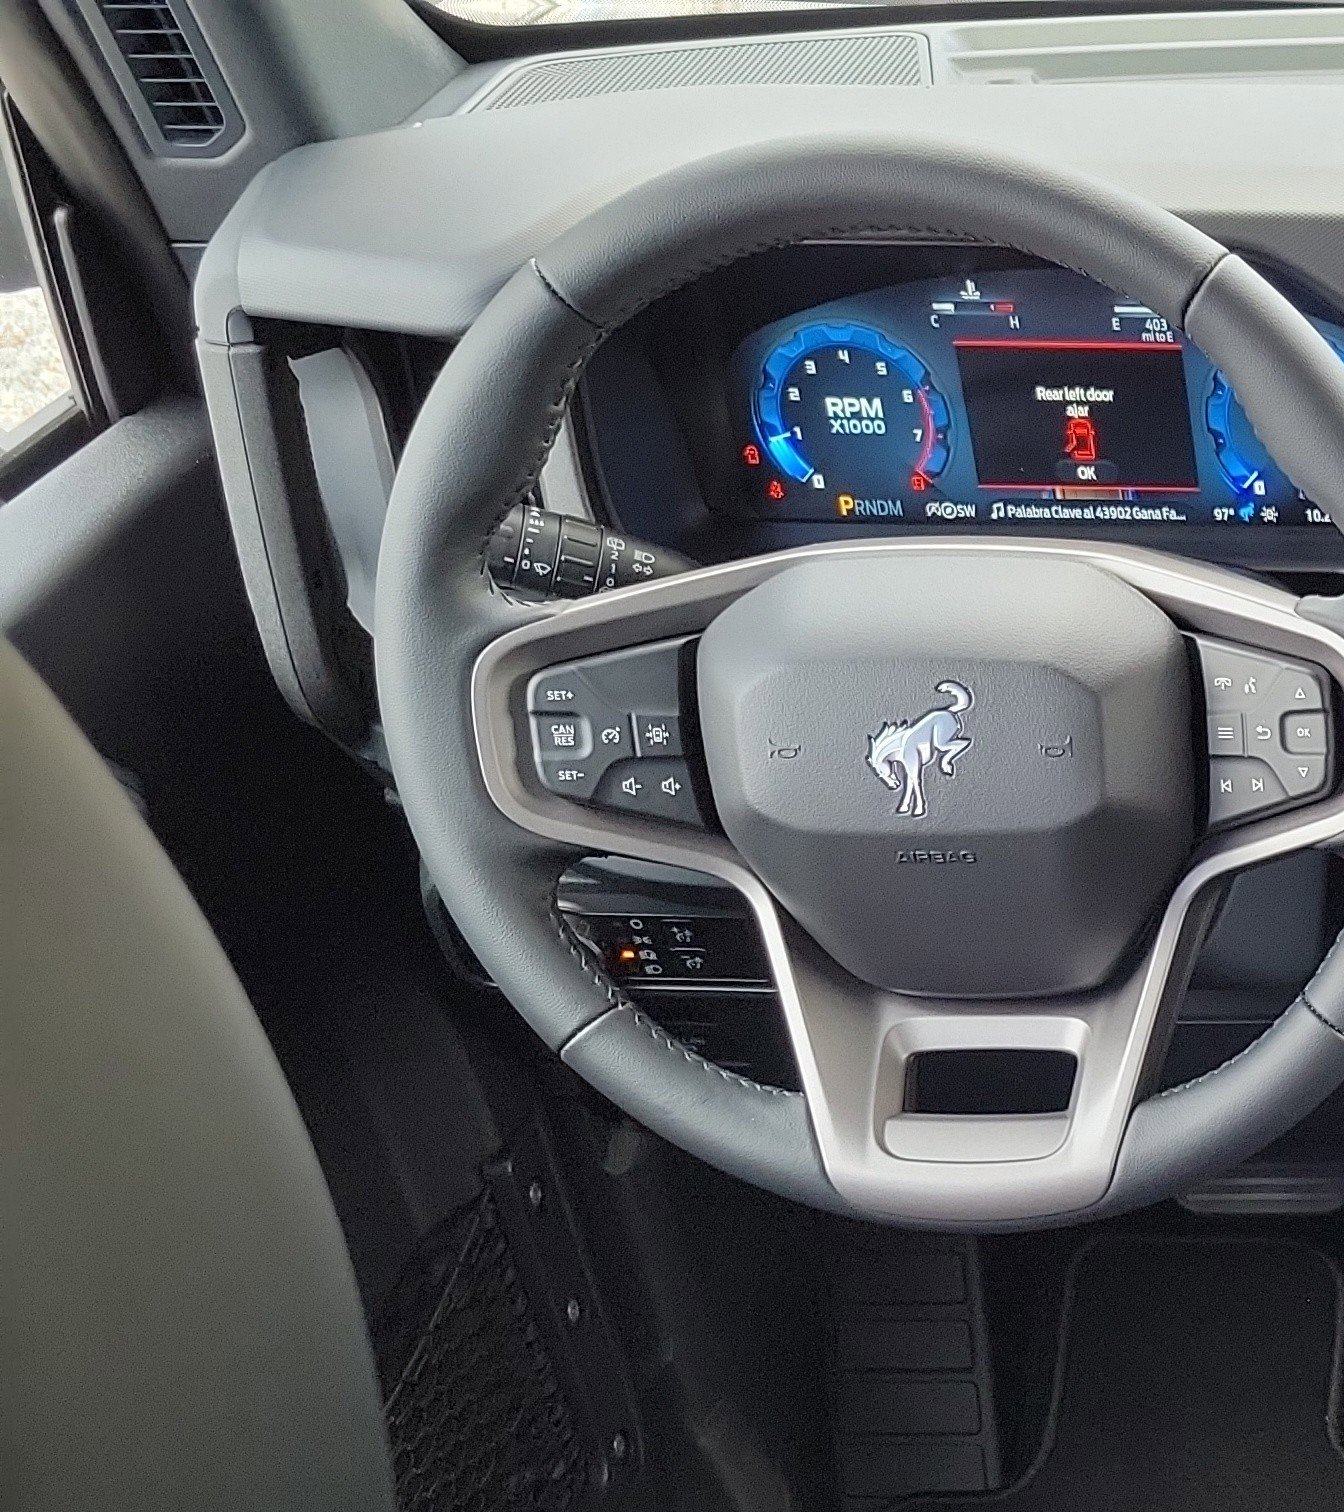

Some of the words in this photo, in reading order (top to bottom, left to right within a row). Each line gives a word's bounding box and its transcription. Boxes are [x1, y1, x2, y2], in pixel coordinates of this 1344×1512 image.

[929, 314, 940, 328] C
[1008, 315, 1021, 329] H
[1112, 317, 1121, 331] E
[1145, 318, 1168, 331] 403
[1155, 332, 1166, 342] to
[1166, 331, 1174, 342] E
[838, 350, 851, 364] 4
[804, 360, 817, 375] 3
[875, 361, 888, 376] 5
[787, 387, 800, 401] 2
[902, 389, 914, 403] 6
[1036, 386, 1064, 401] Rear
[1064, 386, 1086, 402] left
[1086, 387, 1114, 402] door
[824, 397, 884, 419] RPM
[1066, 403, 1089, 419] ajar
[792, 426, 803, 441] 1
[829, 419, 886, 435] X1000
[912, 429, 923, 443] 7
[1077, 466, 1097, 480] OK
[812, 474, 825, 489] 0
[956, 504, 976, 518] SW
[1006, 504, 1051, 519] Palabra
[1051, 504, 1083, 519] Clave
[1083, 505, 1095, 520] al
[1095, 505, 1132, 520] 43902
[1133, 506, 1162, 520] Gana
[1163, 506, 1187, 521] Fa...
[611, 551, 619, 561] 2
[606, 578, 615, 587] 0
[546, 690, 575, 701] SET+
[551, 724, 575, 735] CAN
[1296, 727, 1311, 738] OK
[554, 736, 575, 746] RES
[895, 849, 978, 864] AIRBAG
